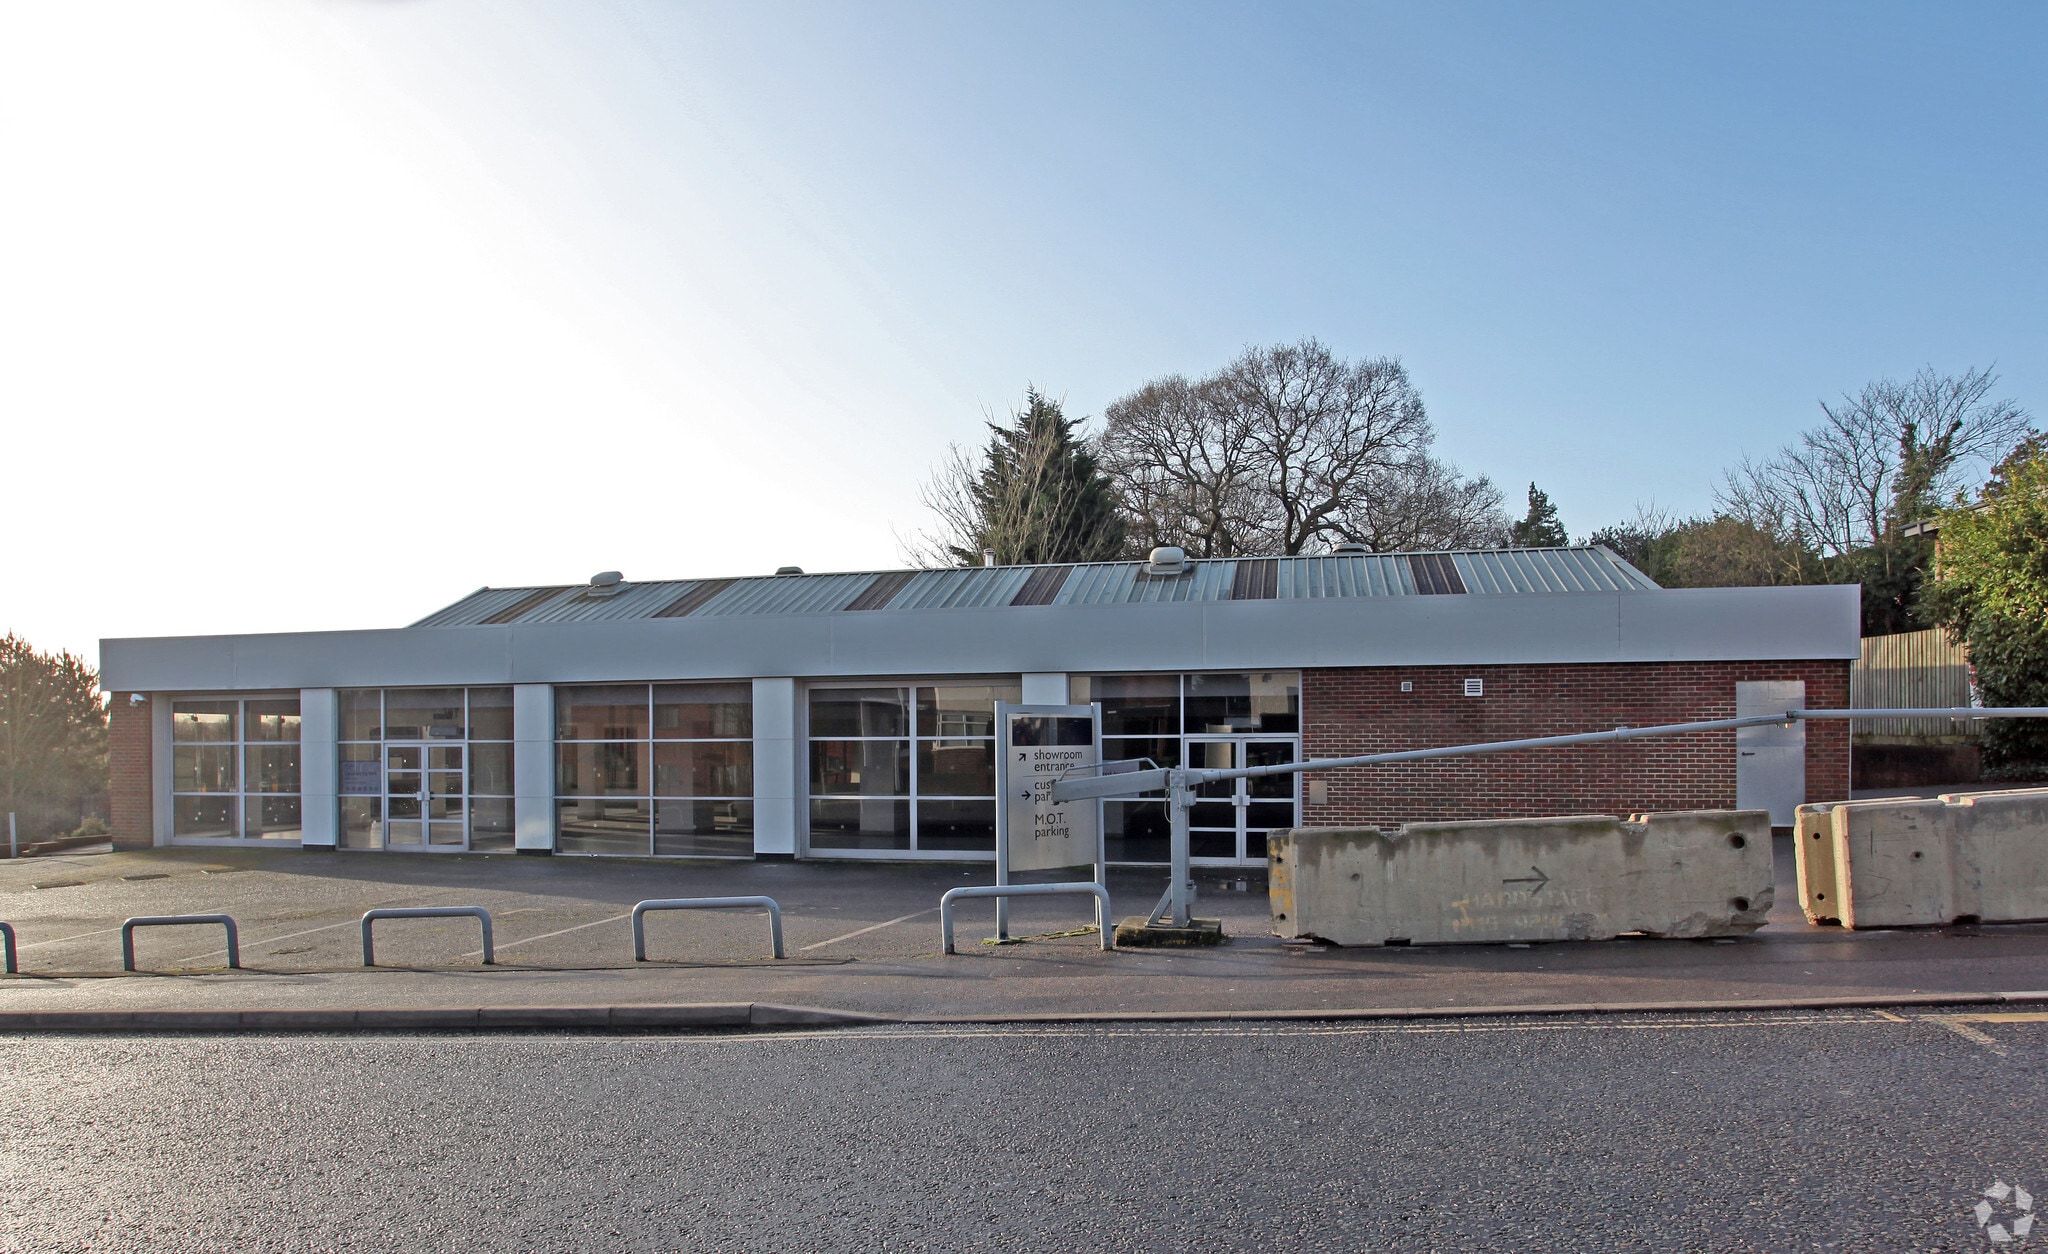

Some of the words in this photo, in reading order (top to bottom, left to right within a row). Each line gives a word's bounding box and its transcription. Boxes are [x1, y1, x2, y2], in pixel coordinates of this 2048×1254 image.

[1034, 748, 1083, 760] showroom
[1034, 812, 1066, 825] M.O.T.
[1034, 825, 1070, 840] parking
